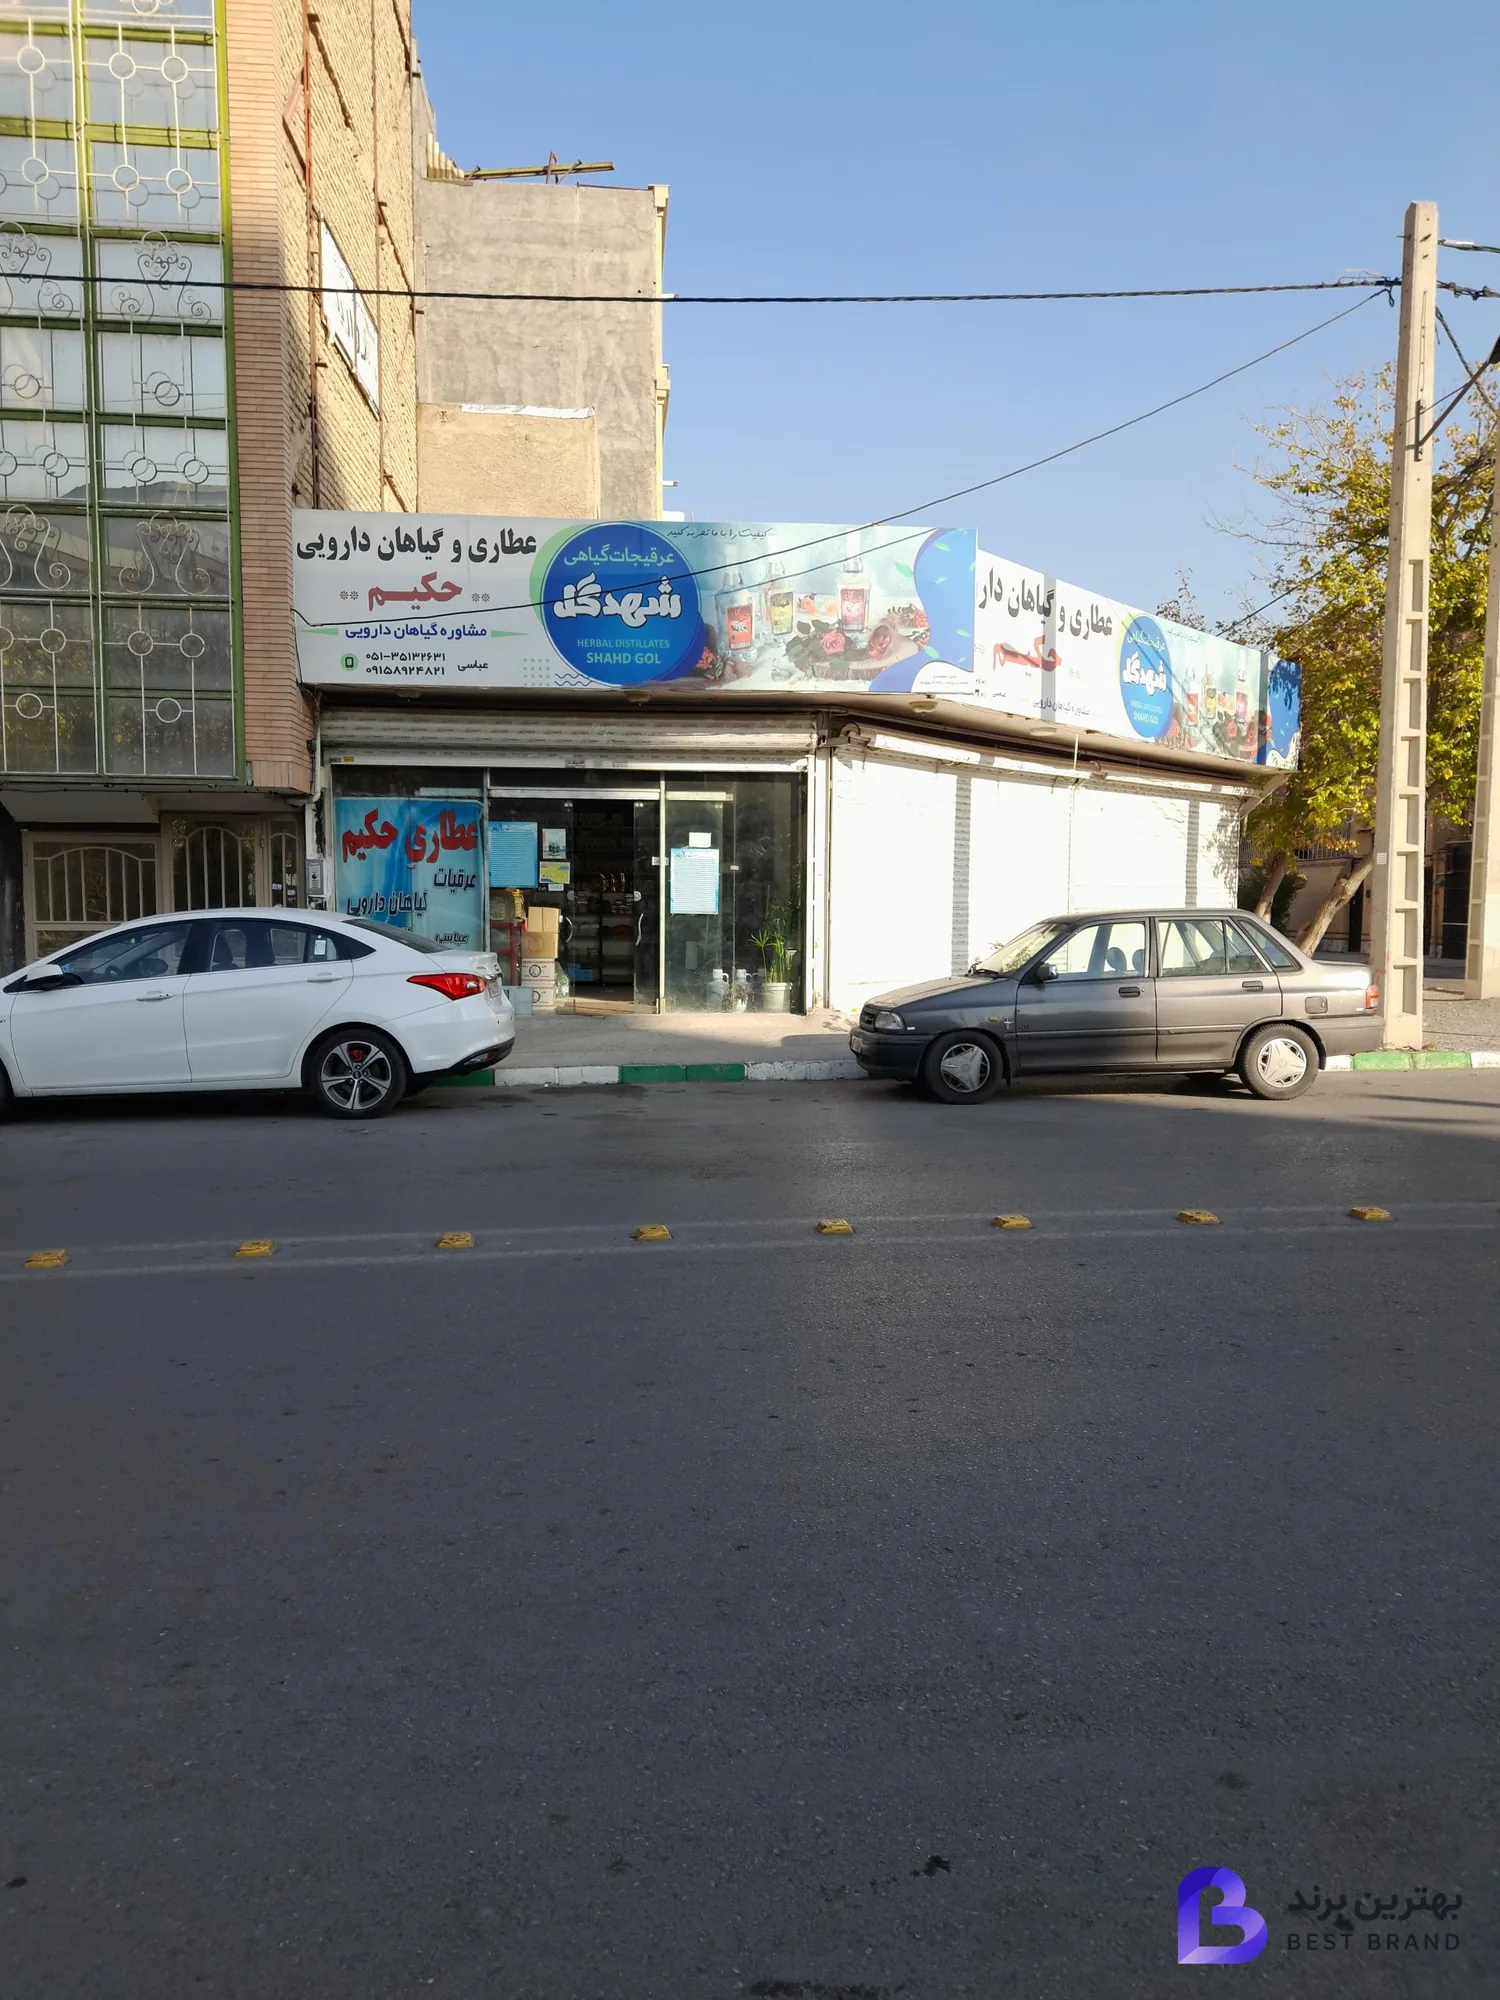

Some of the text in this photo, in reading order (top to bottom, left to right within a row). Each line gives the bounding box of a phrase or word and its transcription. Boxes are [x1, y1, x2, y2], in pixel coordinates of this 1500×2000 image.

[296, 524, 537, 563] عطاری و گیاهان دارویی
[666, 525, 690, 538] کنید
[686, 528, 710, 540] تجربه
[738, 527, 773, 540] کیفیت
[564, 543, 675, 567] عرقیجات گیاهی
[368, 570, 463, 611] حکیم
[1007, 578, 1055, 626] گیاهان
[345, 621, 488, 640] مشاوره گیاهان دارویی
[1058, 605, 1066, 633] و
[1069, 603, 1113, 641] عطاری
[577, 638, 670, 649] HERBAL DISTILLATES
[993, 634, 1063, 678] حکیم
[457, 659, 489, 672] عباسی
[586, 652, 661, 664] SHAHD GOL
[342, 808, 399, 864] حکیم
[405, 808, 479, 864] عطاری
[433, 867, 477, 895] عرقیات
[388, 889, 428, 917] گیاهان
